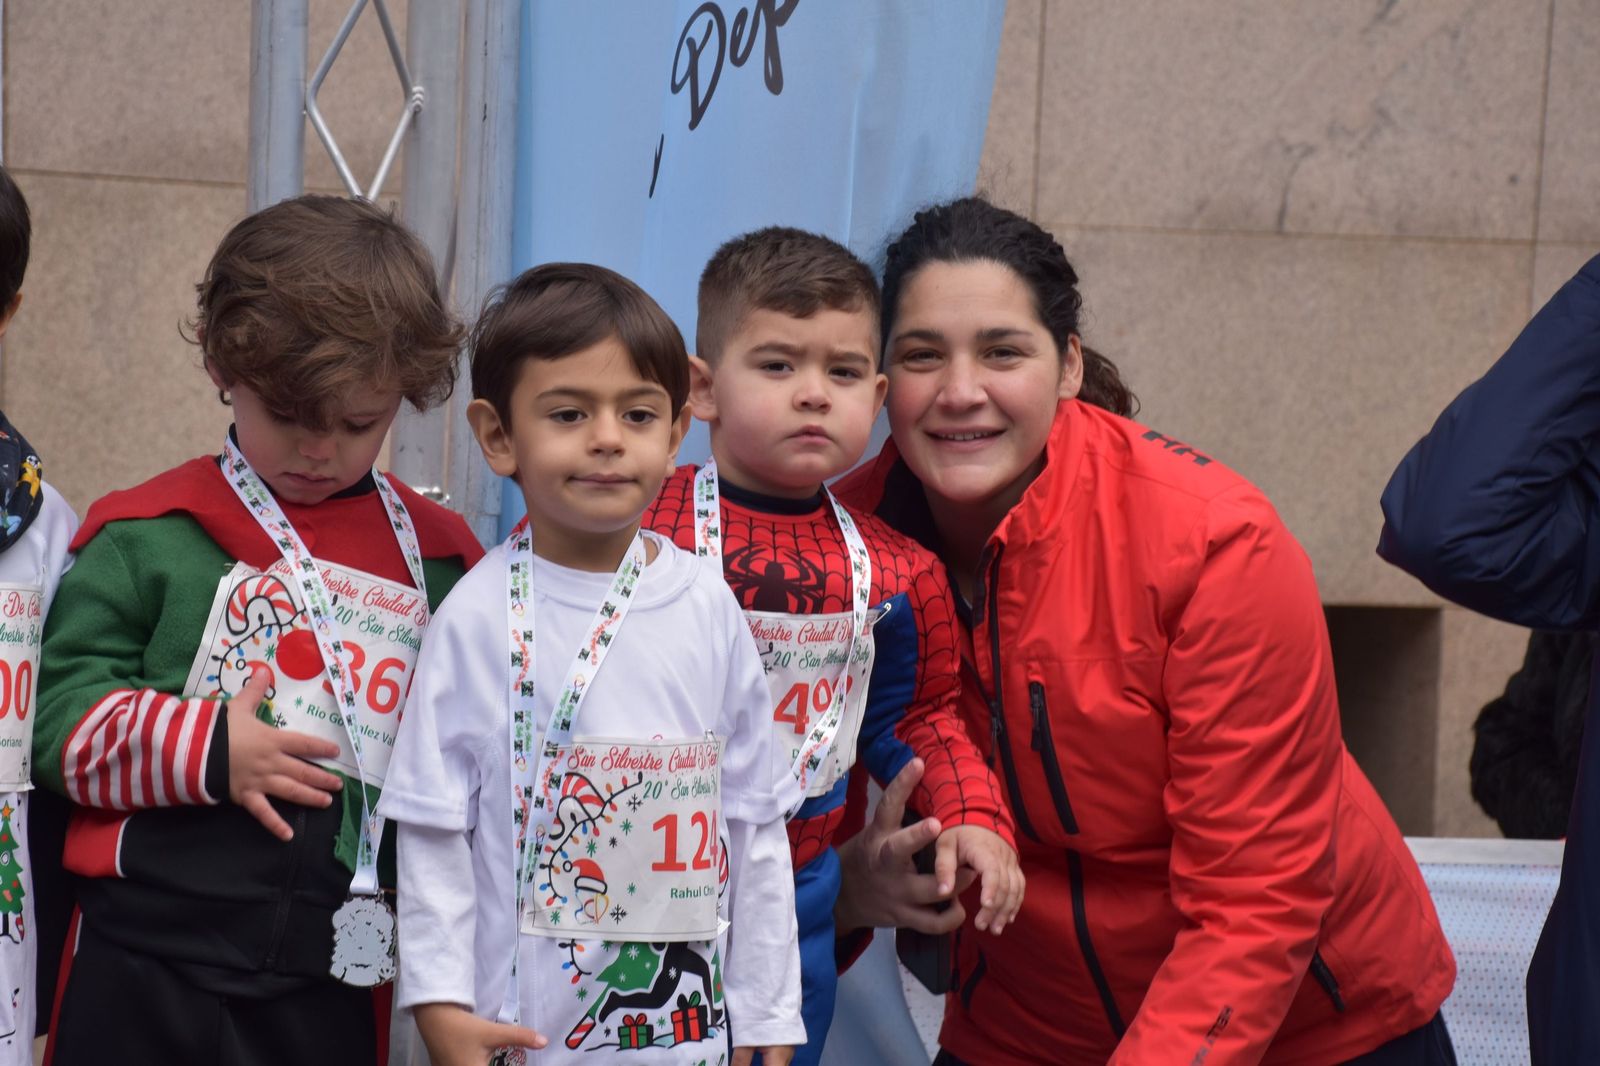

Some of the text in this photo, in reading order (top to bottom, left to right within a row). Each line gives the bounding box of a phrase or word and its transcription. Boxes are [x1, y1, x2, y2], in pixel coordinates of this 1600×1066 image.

[3, 591, 25, 618] De
[321, 568, 359, 599] lvestre
[363, 585, 418, 617] Ciudad
[359, 613, 385, 635] San
[797, 620, 839, 645] Ciudad
[799, 649, 821, 670] San
[567, 745, 596, 770] San
[601, 746, 663, 772] Silvestre
[668, 746, 698, 773] Ciudad
[670, 777, 689, 800] San
[652, 809, 719, 871] 124
[671, 886, 702, 899] Rahul
